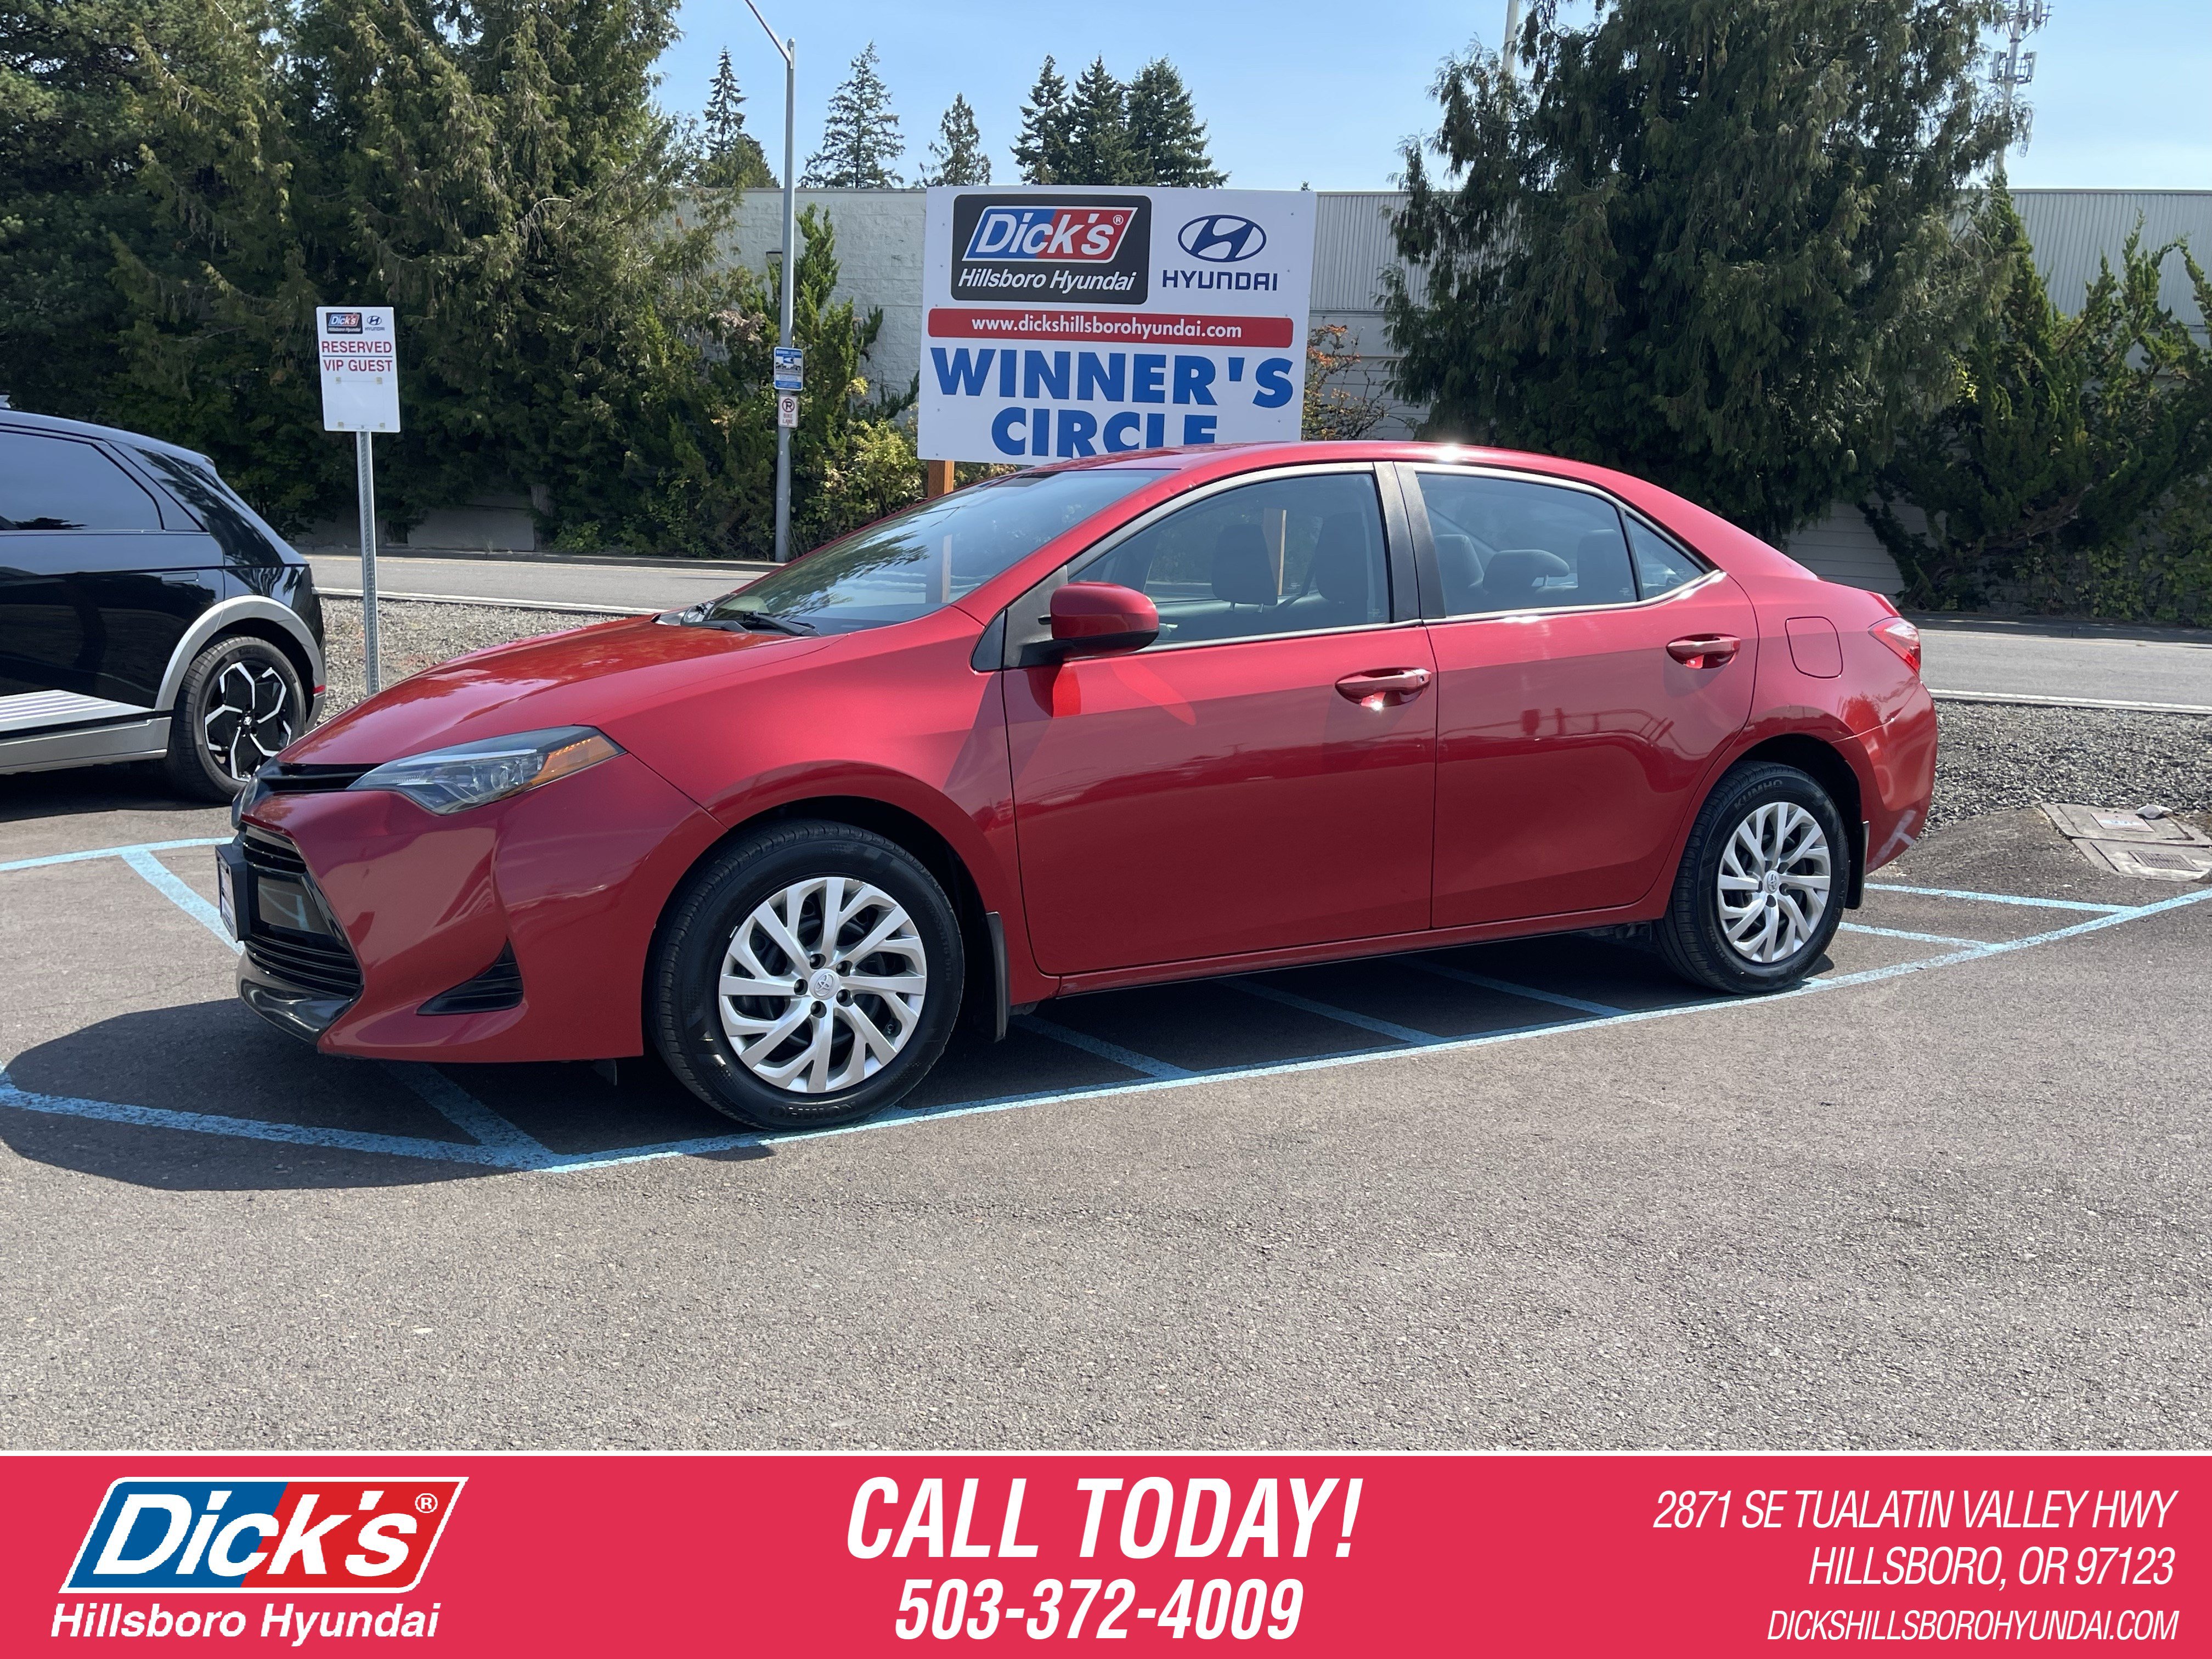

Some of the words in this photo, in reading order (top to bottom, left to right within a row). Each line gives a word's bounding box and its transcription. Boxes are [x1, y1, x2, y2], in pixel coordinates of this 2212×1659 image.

[958, 268, 1046, 288] Hillsboro
[1049, 270, 1137, 294] Hyundai
[1163, 270, 1278, 291] HYUNDAI
[971, 314, 1242, 340] www.dickshillsborohyundai.com
[321, 341, 392, 353] RESERVED
[323, 359, 344, 371] VIP
[348, 359, 393, 372] GUEST
[930, 347, 1294, 409] WINNER'S
